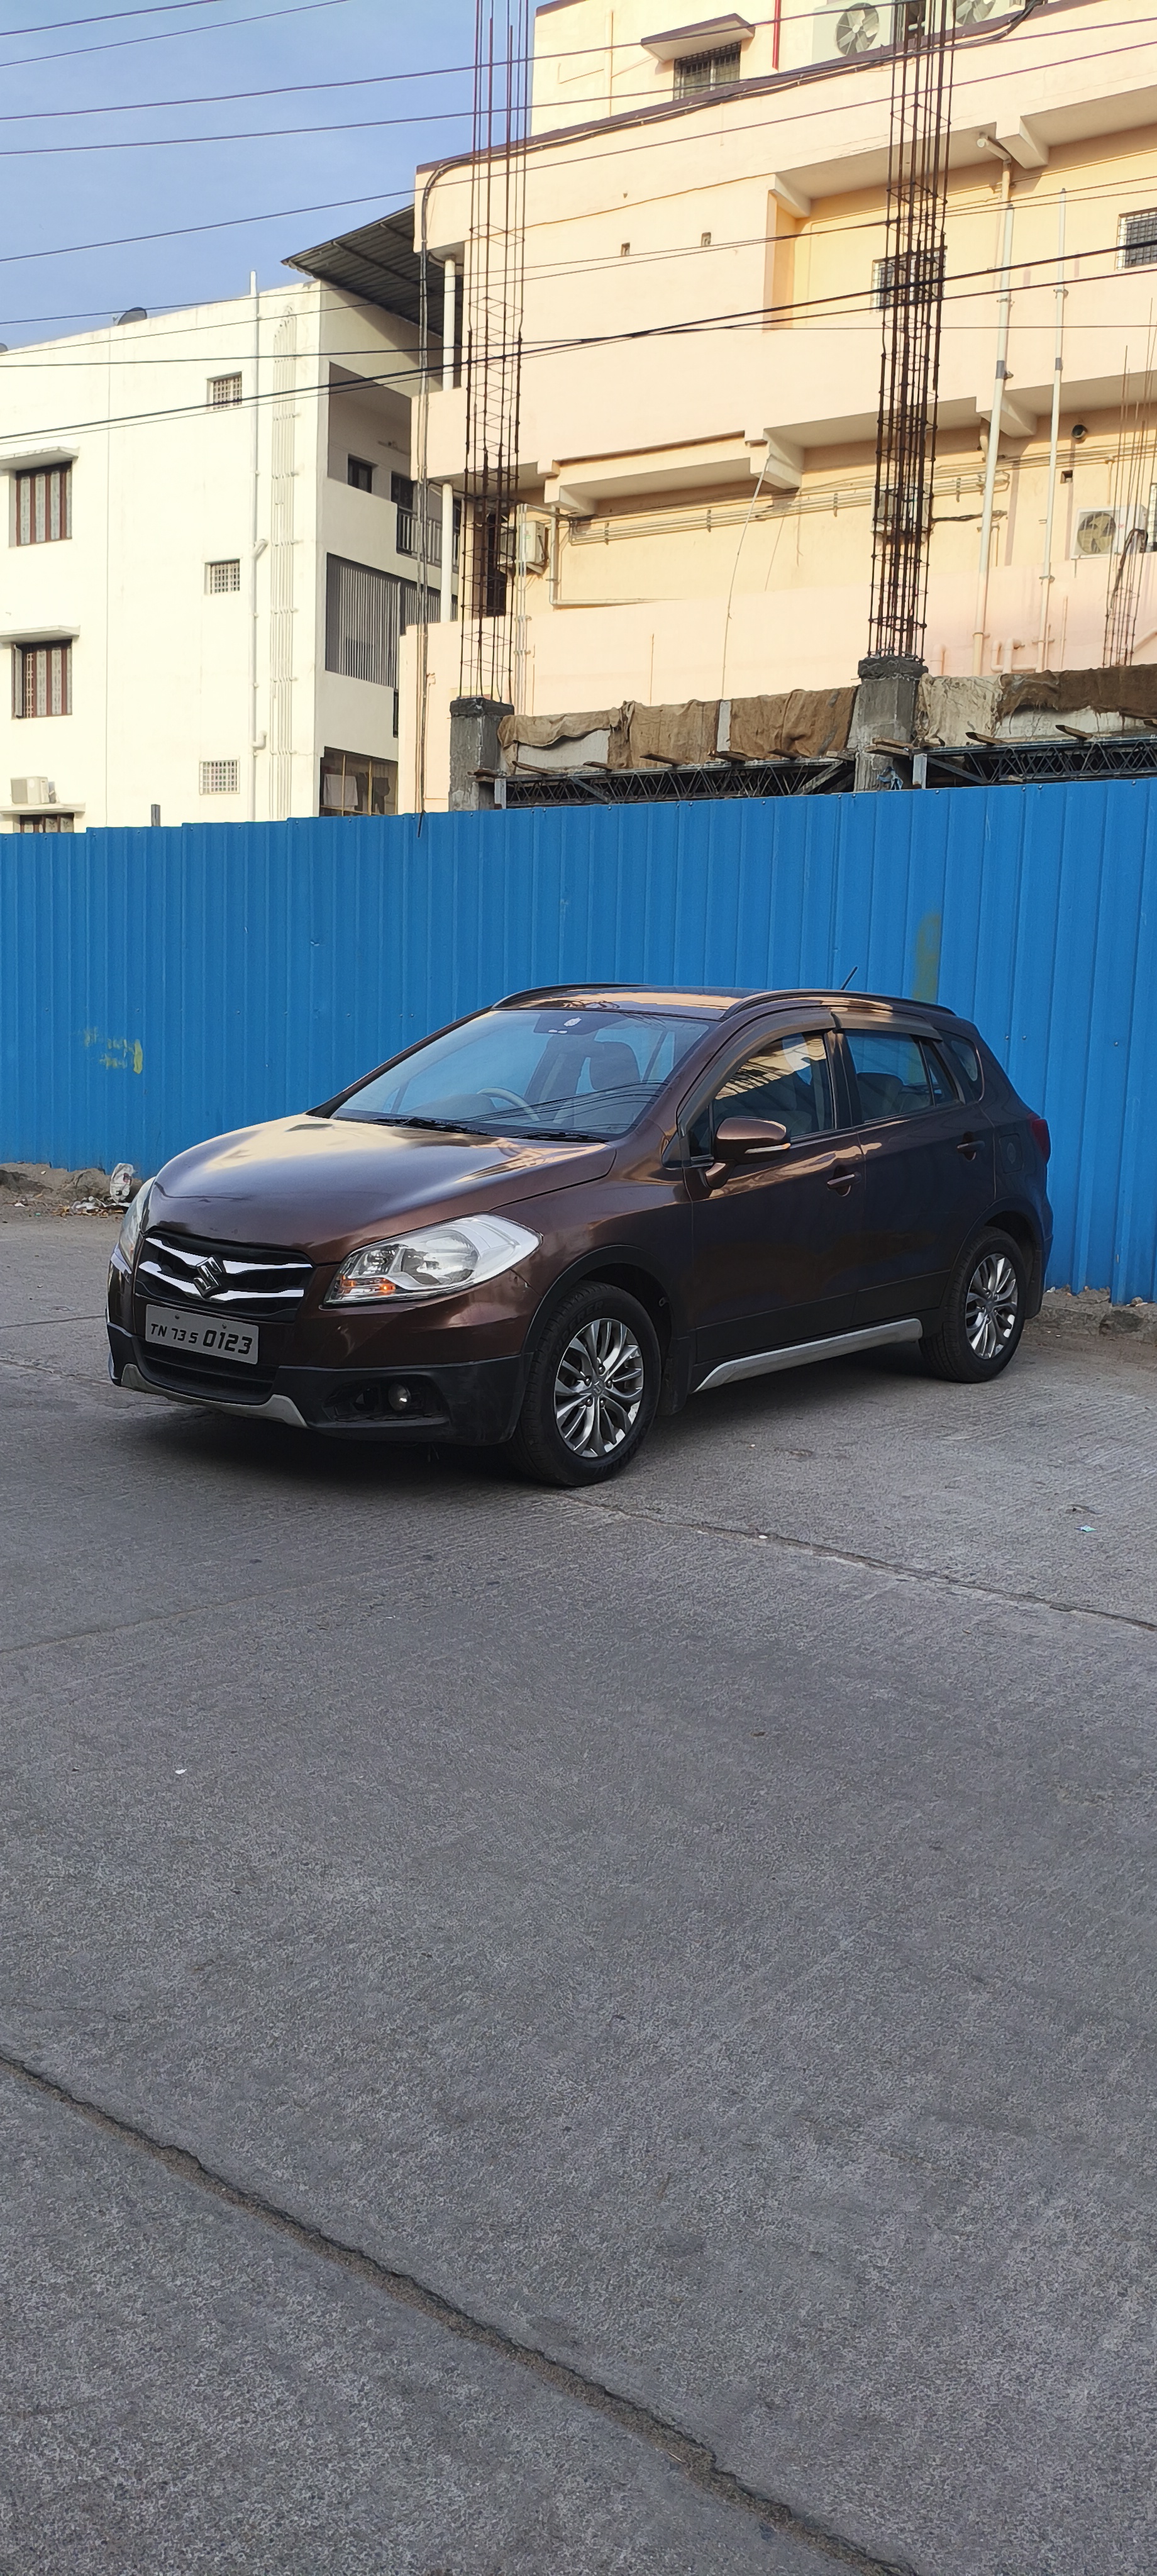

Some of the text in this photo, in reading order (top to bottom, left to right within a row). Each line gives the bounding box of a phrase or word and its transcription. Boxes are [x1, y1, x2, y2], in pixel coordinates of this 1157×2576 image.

[151, 1324, 253, 1355] TN 73 S 0123
